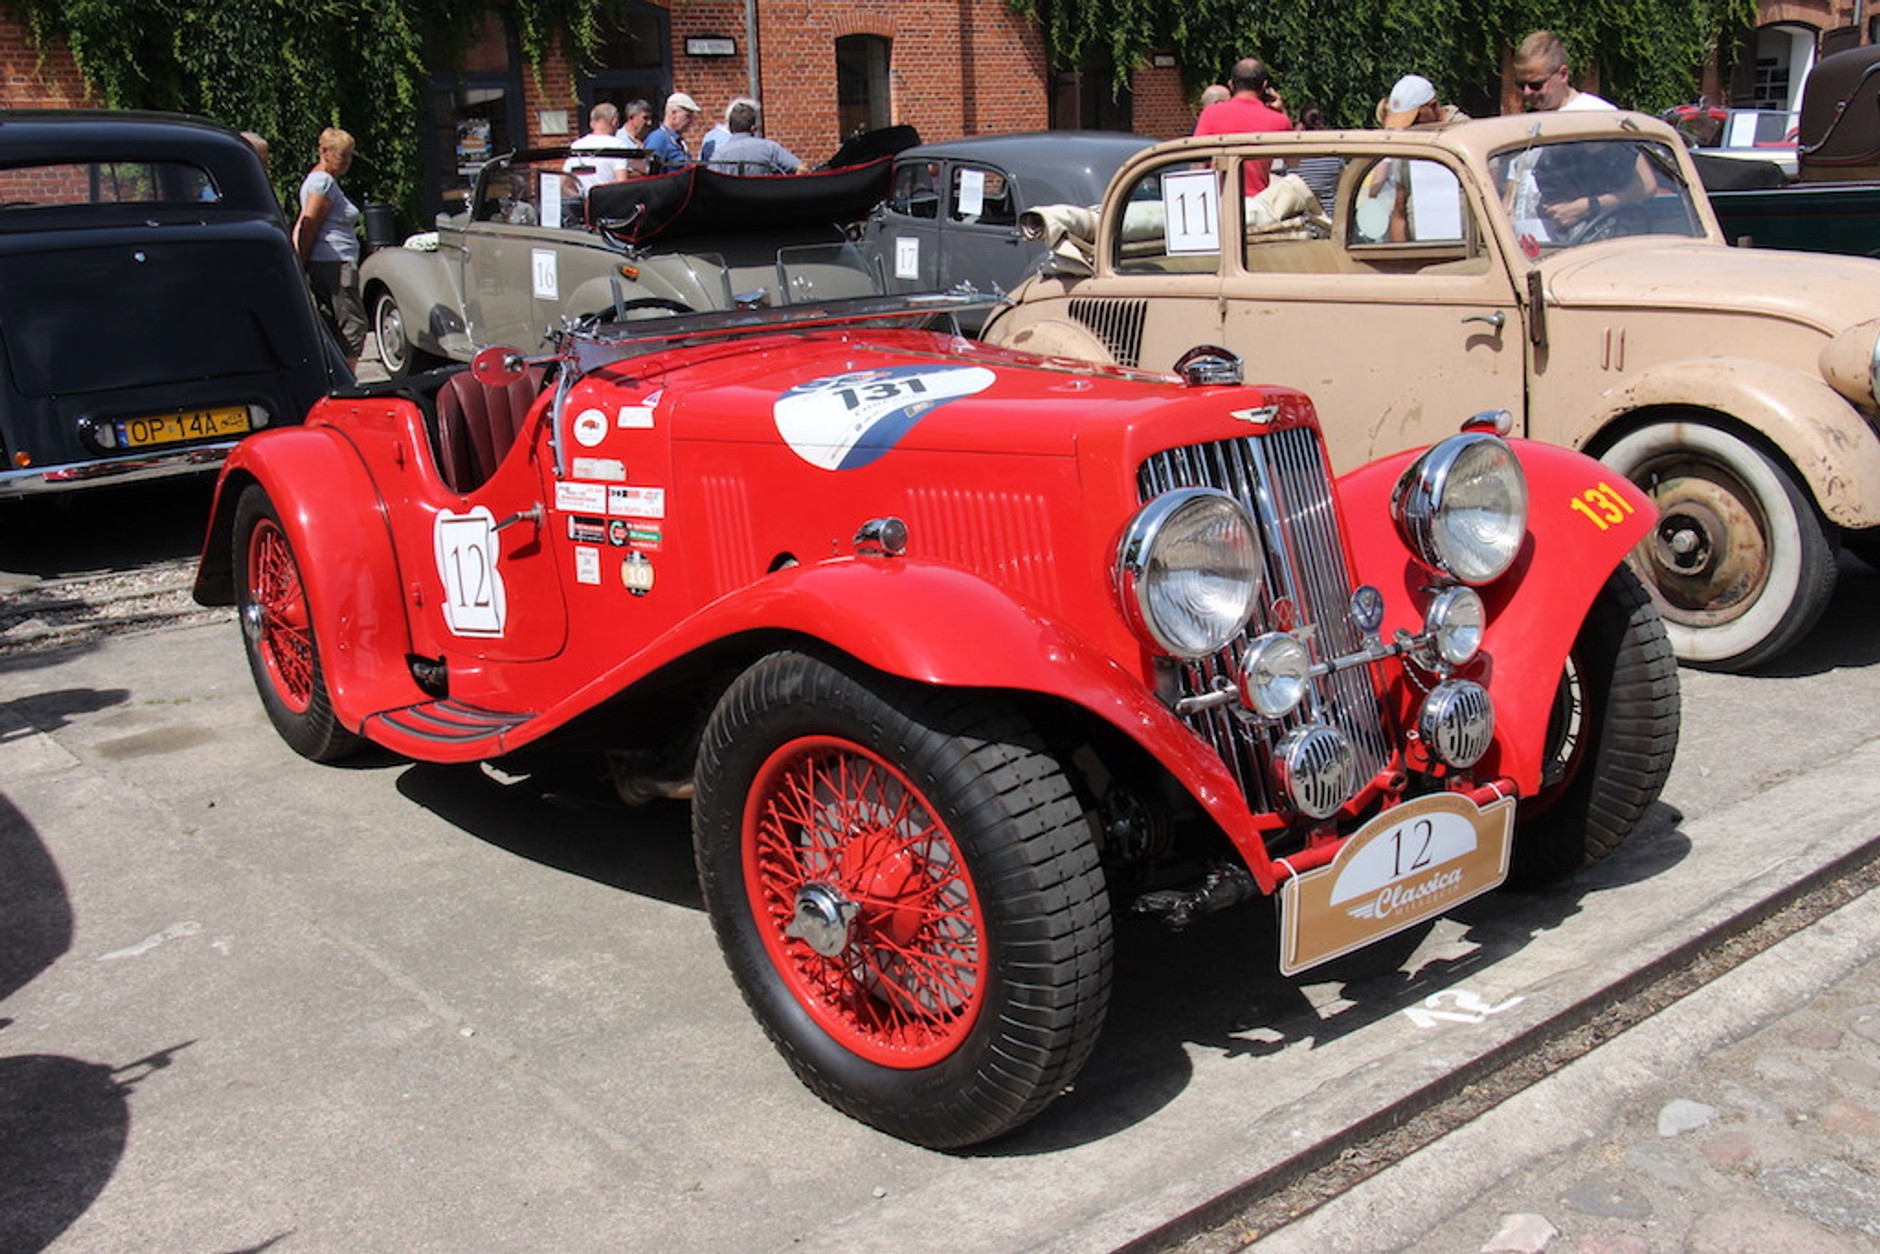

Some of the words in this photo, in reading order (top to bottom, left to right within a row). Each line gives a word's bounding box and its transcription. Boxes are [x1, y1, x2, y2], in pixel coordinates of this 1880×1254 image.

[1176, 191, 1212, 236] 11
[537, 262, 554, 290] 16
[900, 248, 916, 269] 17
[832, 378, 927, 410] 131
[132, 418, 165, 443] OP
[176, 411, 218, 437] 14A
[1570, 481, 1635, 531] 131
[449, 542, 491, 608] 12
[628, 567, 648, 583] 10
[1389, 818, 1434, 880] 12
[1375, 866, 1463, 919] Classica
[1403, 988, 1527, 1029] 12
